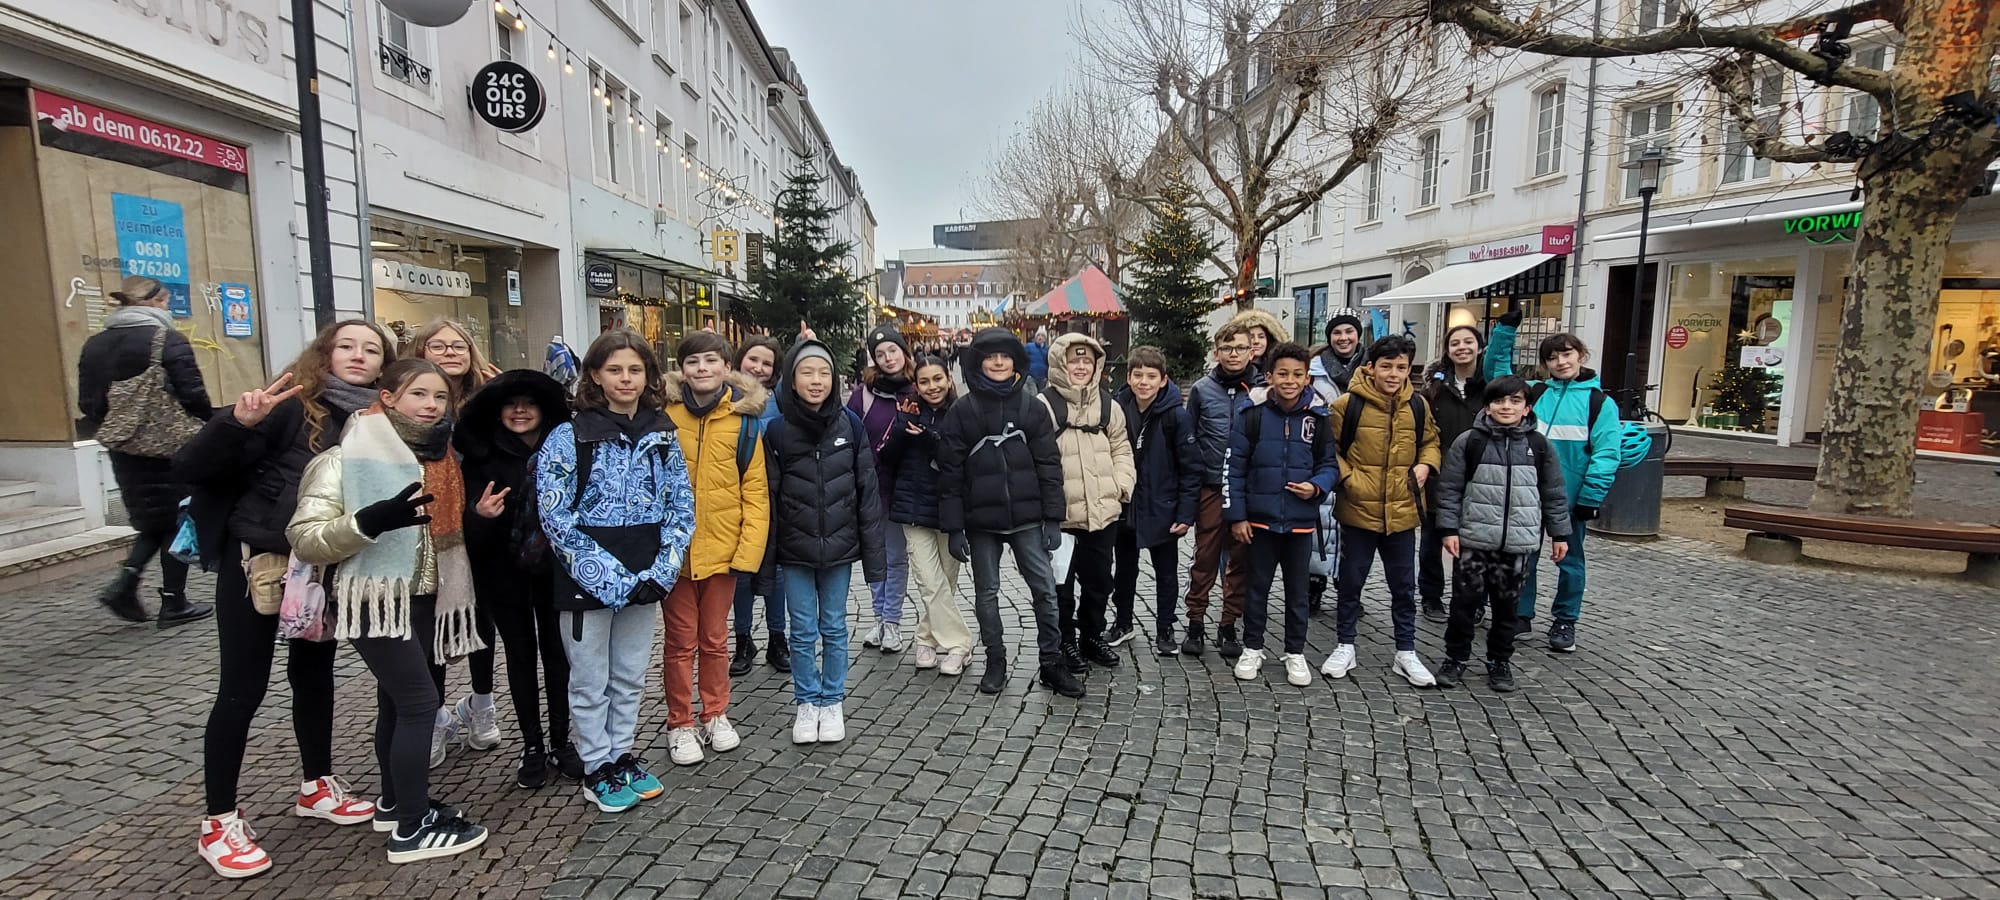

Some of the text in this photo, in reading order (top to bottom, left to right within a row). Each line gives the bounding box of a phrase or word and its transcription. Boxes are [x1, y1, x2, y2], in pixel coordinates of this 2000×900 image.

[487, 71, 525, 88] 24C
[485, 86, 527, 104] OLO
[487, 102, 526, 119] URS
[60, 105, 204, 159] ab dem 06.12.22
[118, 220, 184, 239] vermieten
[944, 224, 977, 233] KARSTADT
[135, 240, 170, 258] 0681
[747, 241, 758, 262] Villa
[127, 258, 181, 278] 876280
[1678, 319, 1722, 327] VORWERK
